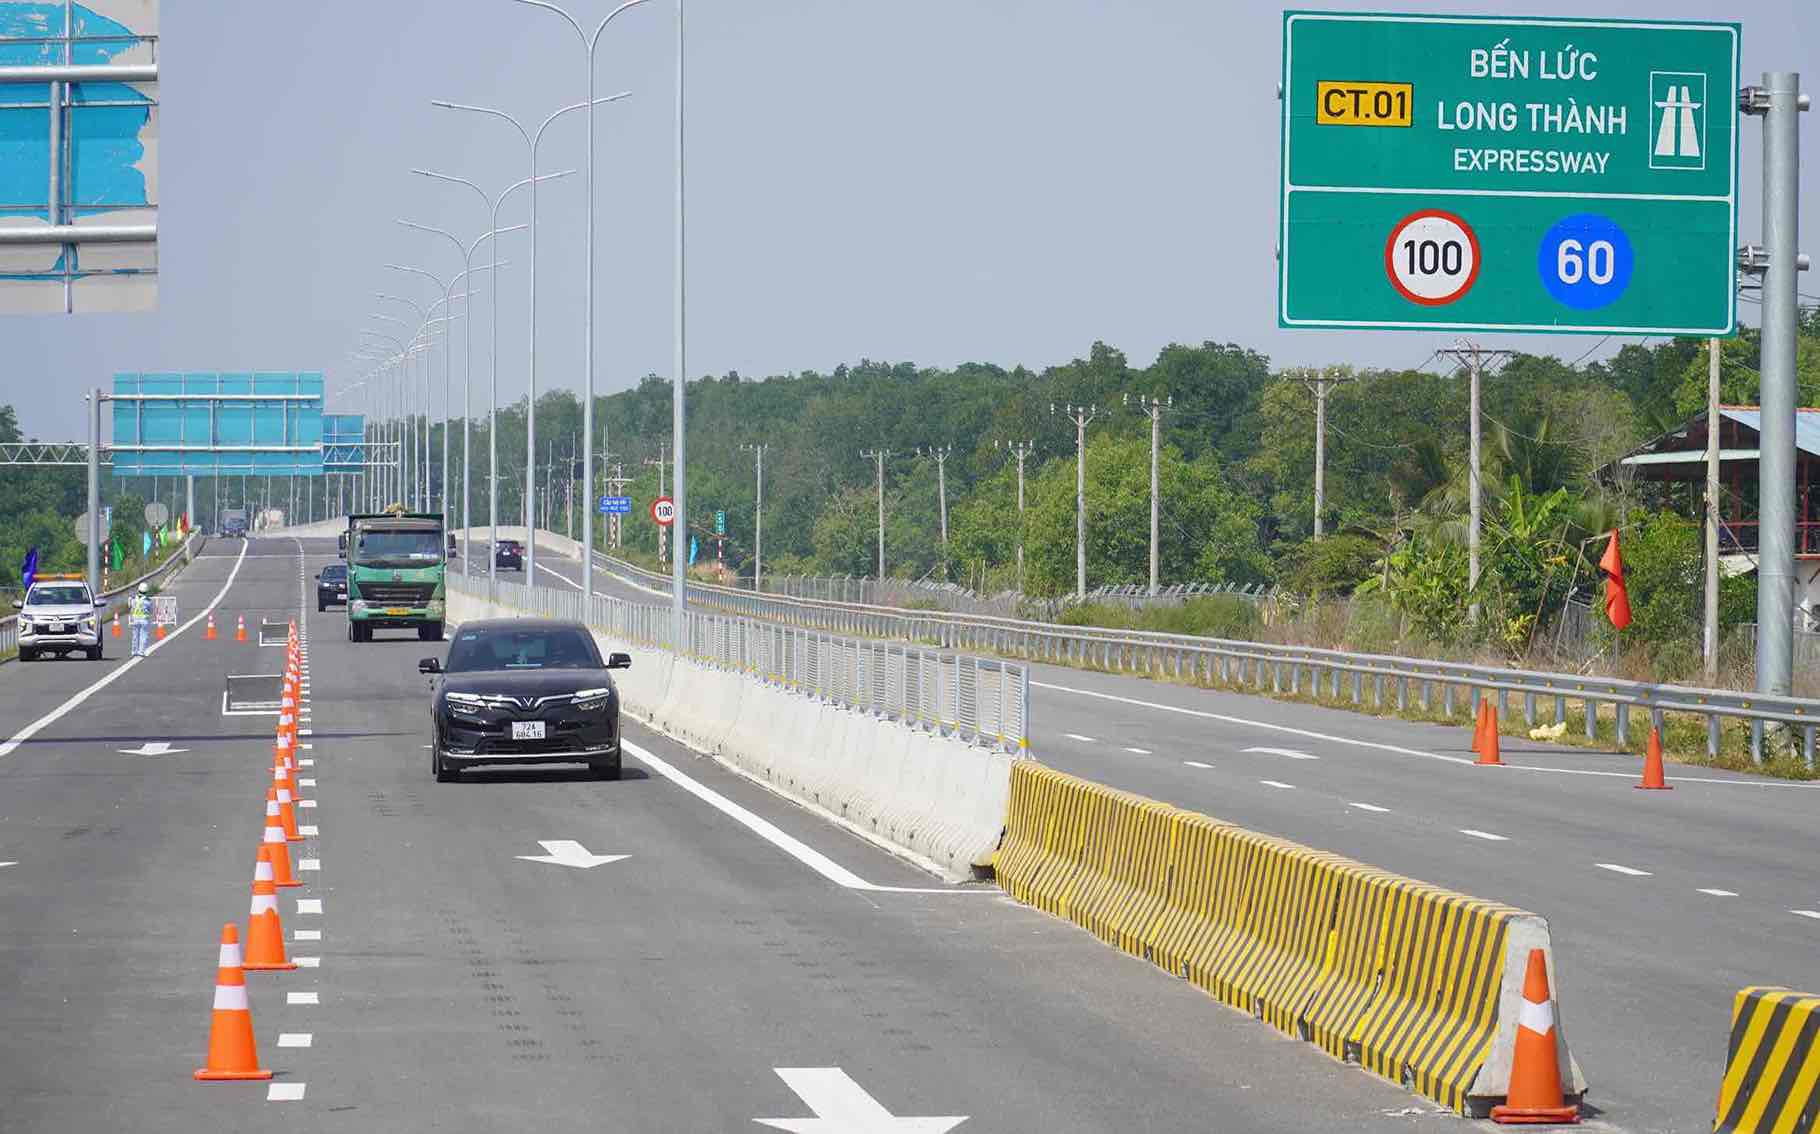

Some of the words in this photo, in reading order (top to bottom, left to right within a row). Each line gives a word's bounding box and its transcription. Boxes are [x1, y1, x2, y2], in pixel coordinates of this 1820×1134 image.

[1470, 38, 1529, 79] BẾN
[1539, 44, 1598, 81] LỨC
[1324, 88, 1406, 120] CT.01
[1437, 101, 1518, 131] LONG
[1525, 98, 1627, 135] THÀNH
[1454, 148, 1610, 174] EXPRESSWAY
[1404, 240, 1462, 276] 100
[1557, 239, 1615, 285] 60
[656, 506, 673, 517] 100
